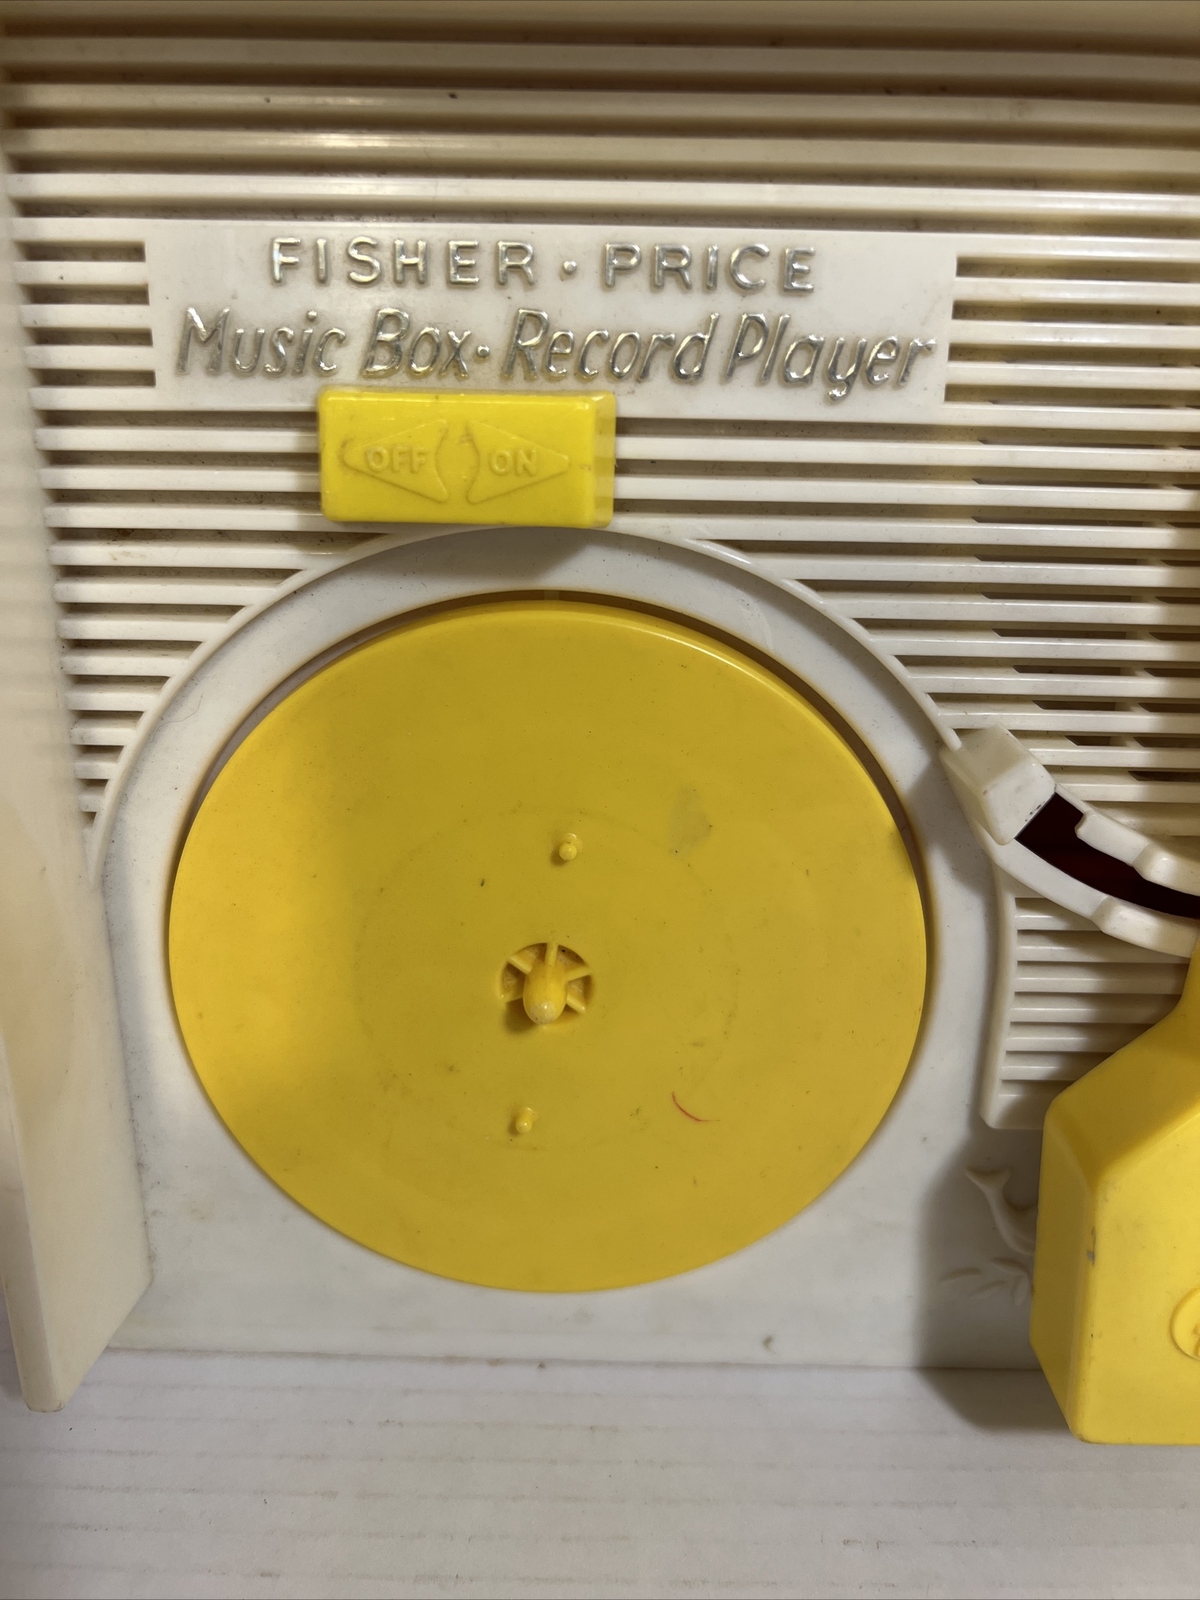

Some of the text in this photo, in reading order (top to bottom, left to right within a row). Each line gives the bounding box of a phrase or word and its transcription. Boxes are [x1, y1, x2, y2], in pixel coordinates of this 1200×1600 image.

[270, 235, 816, 292] FISHER PRICE
[176, 306, 347, 376] Music
[504, 308, 720, 384] Record
[724, 312, 938, 402] Player
[365, 446, 426, 474] OFF
[490, 449, 538, 477] ON
